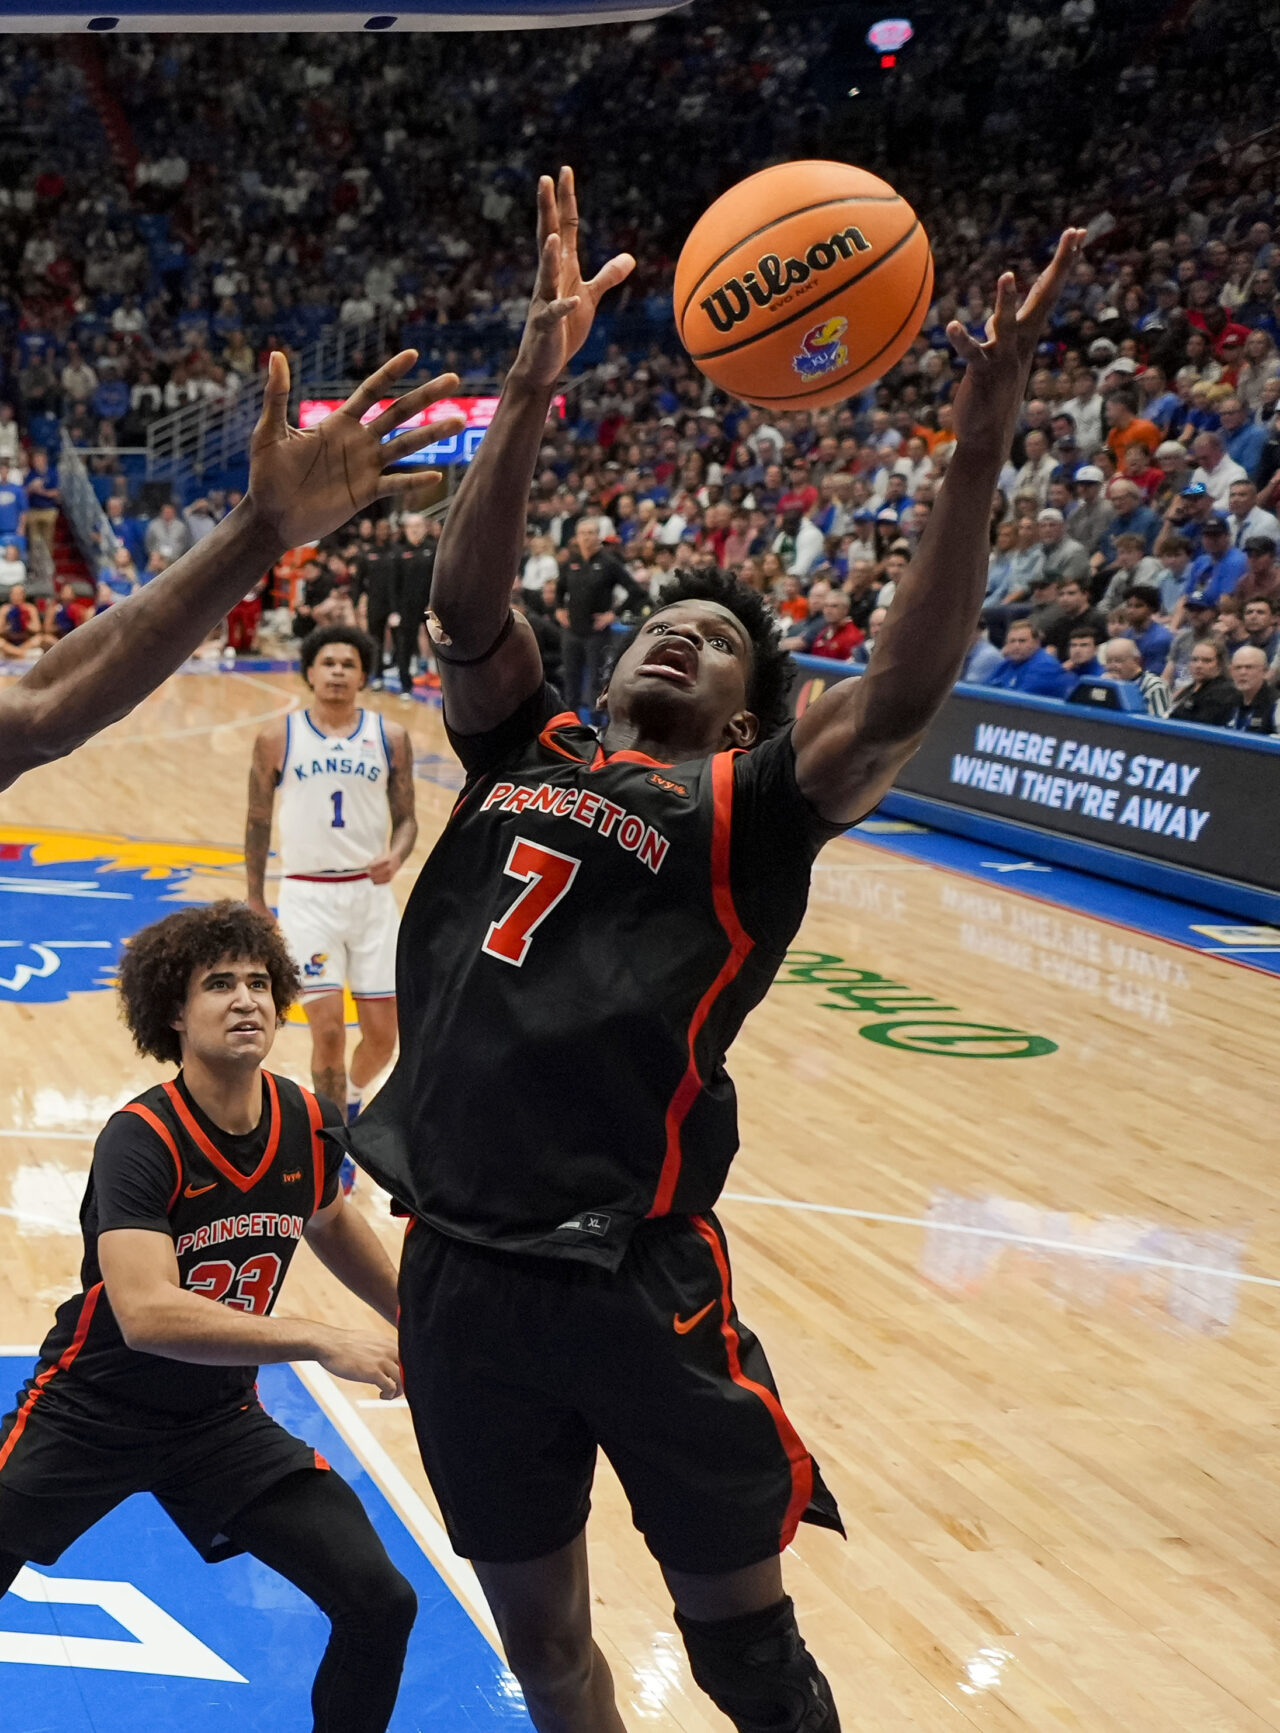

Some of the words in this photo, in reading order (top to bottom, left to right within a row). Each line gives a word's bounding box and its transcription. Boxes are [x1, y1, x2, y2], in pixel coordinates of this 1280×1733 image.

[700, 226, 872, 333] Wilson
[770, 295, 794, 312] EVO
[796, 279, 819, 296] NXT
[295, 758, 381, 782] KANSAS
[651, 773, 675, 790] Ivy
[975, 723, 1057, 766] WHERE
[1057, 741, 1126, 781] FANS
[1126, 755, 1200, 796] STAY
[331, 790, 345, 828] 1
[950, 754, 1018, 795] WHEN
[1021, 770, 1119, 820] THEY'RE
[1119, 795, 1210, 842] AWAY
[480, 783, 670, 875] PRNCETON
[481, 836, 582, 968] 7
[176, 1212, 304, 1257] PRINCETON
[587, 1217, 601, 1229] XL
[186, 1252, 283, 1317] 23
